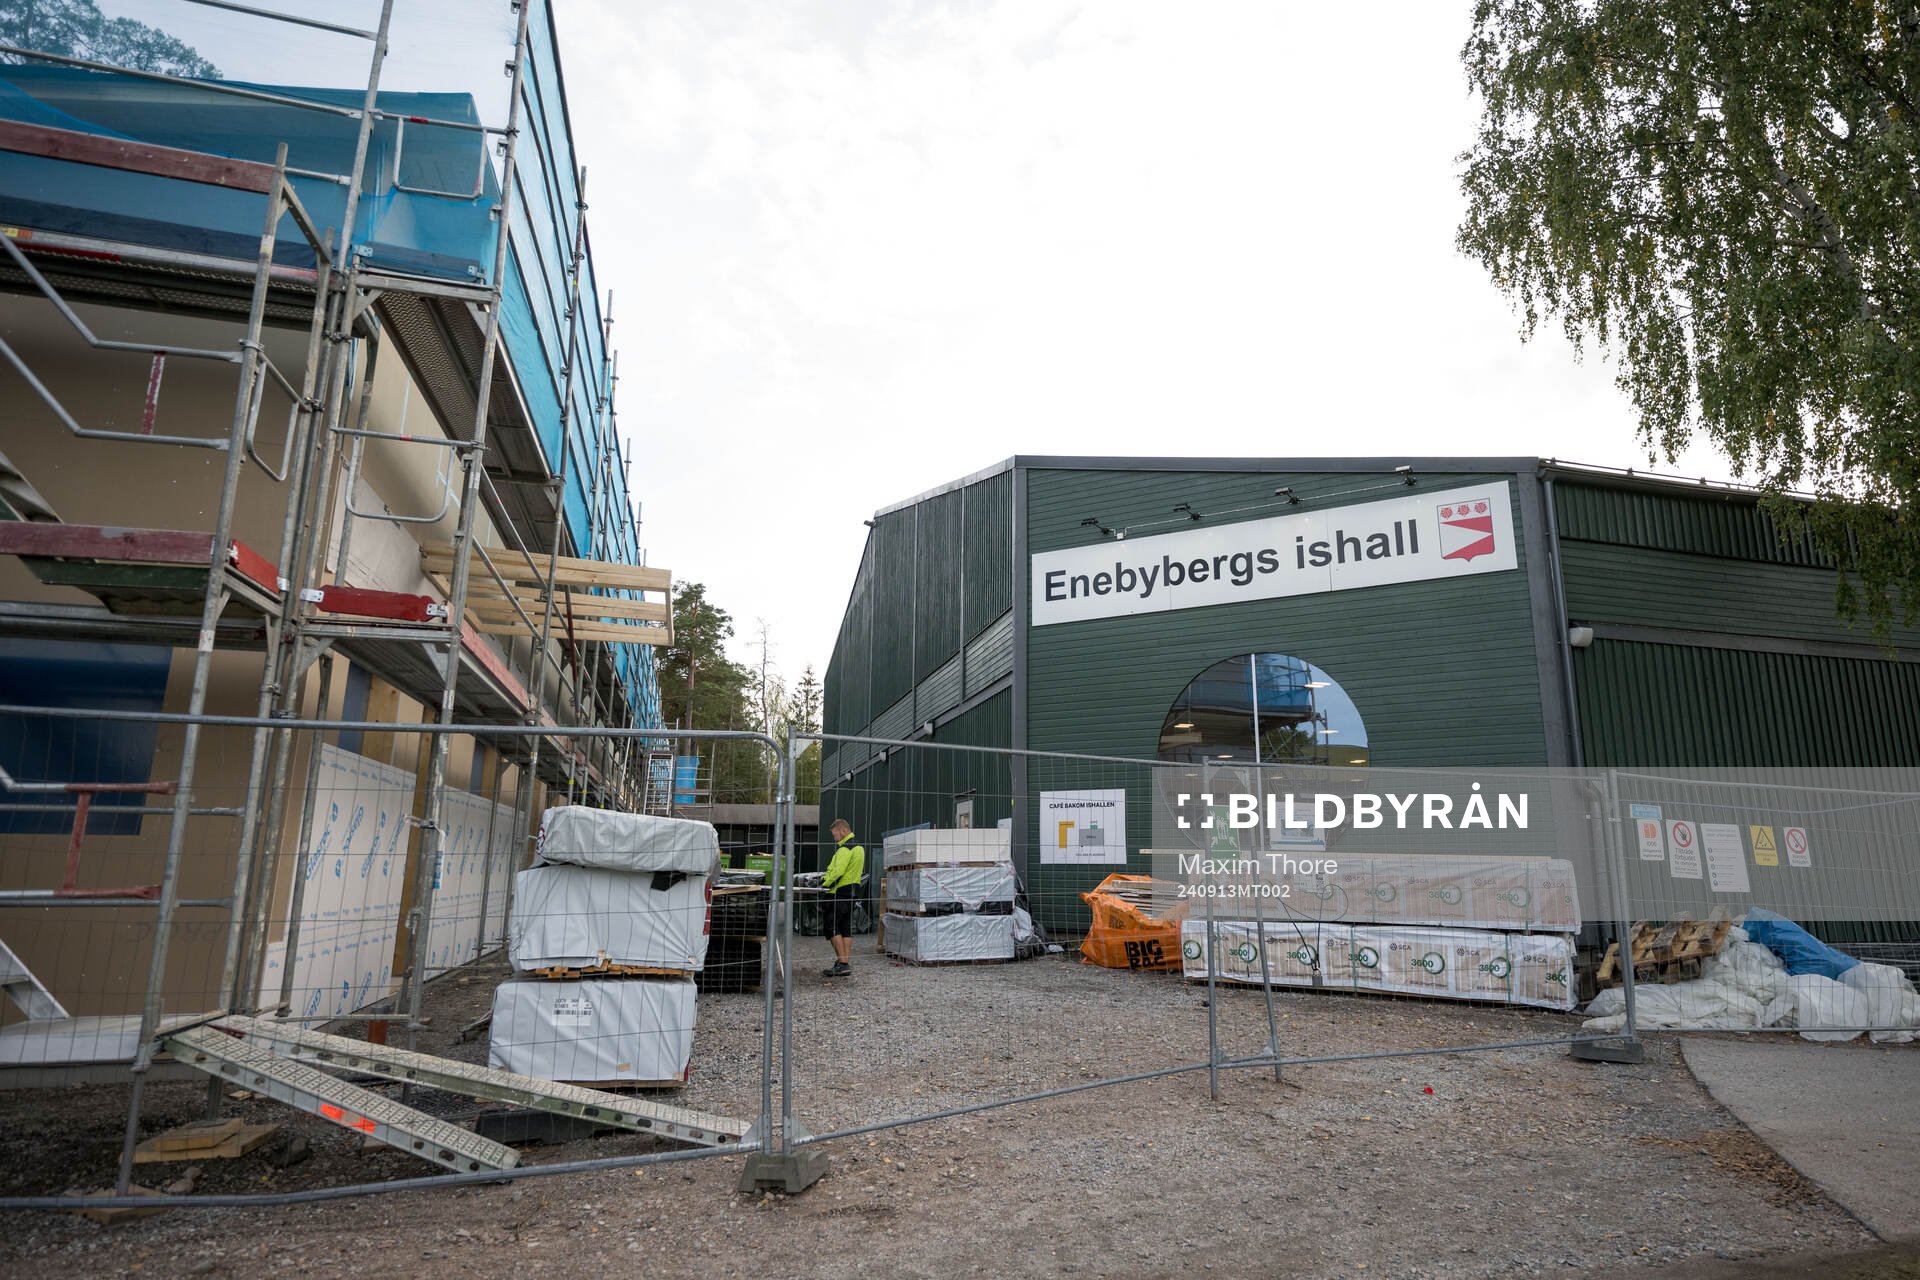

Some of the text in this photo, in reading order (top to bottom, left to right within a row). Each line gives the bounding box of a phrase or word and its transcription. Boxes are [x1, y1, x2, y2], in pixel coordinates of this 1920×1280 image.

[1045, 519, 1419, 602] Enebybergs ishall
[1428, 891, 1451, 900] 3600
[1496, 893, 1519, 902] 3600
[1125, 940, 1164, 957] BIG
[1411, 958, 1434, 968] 3600
